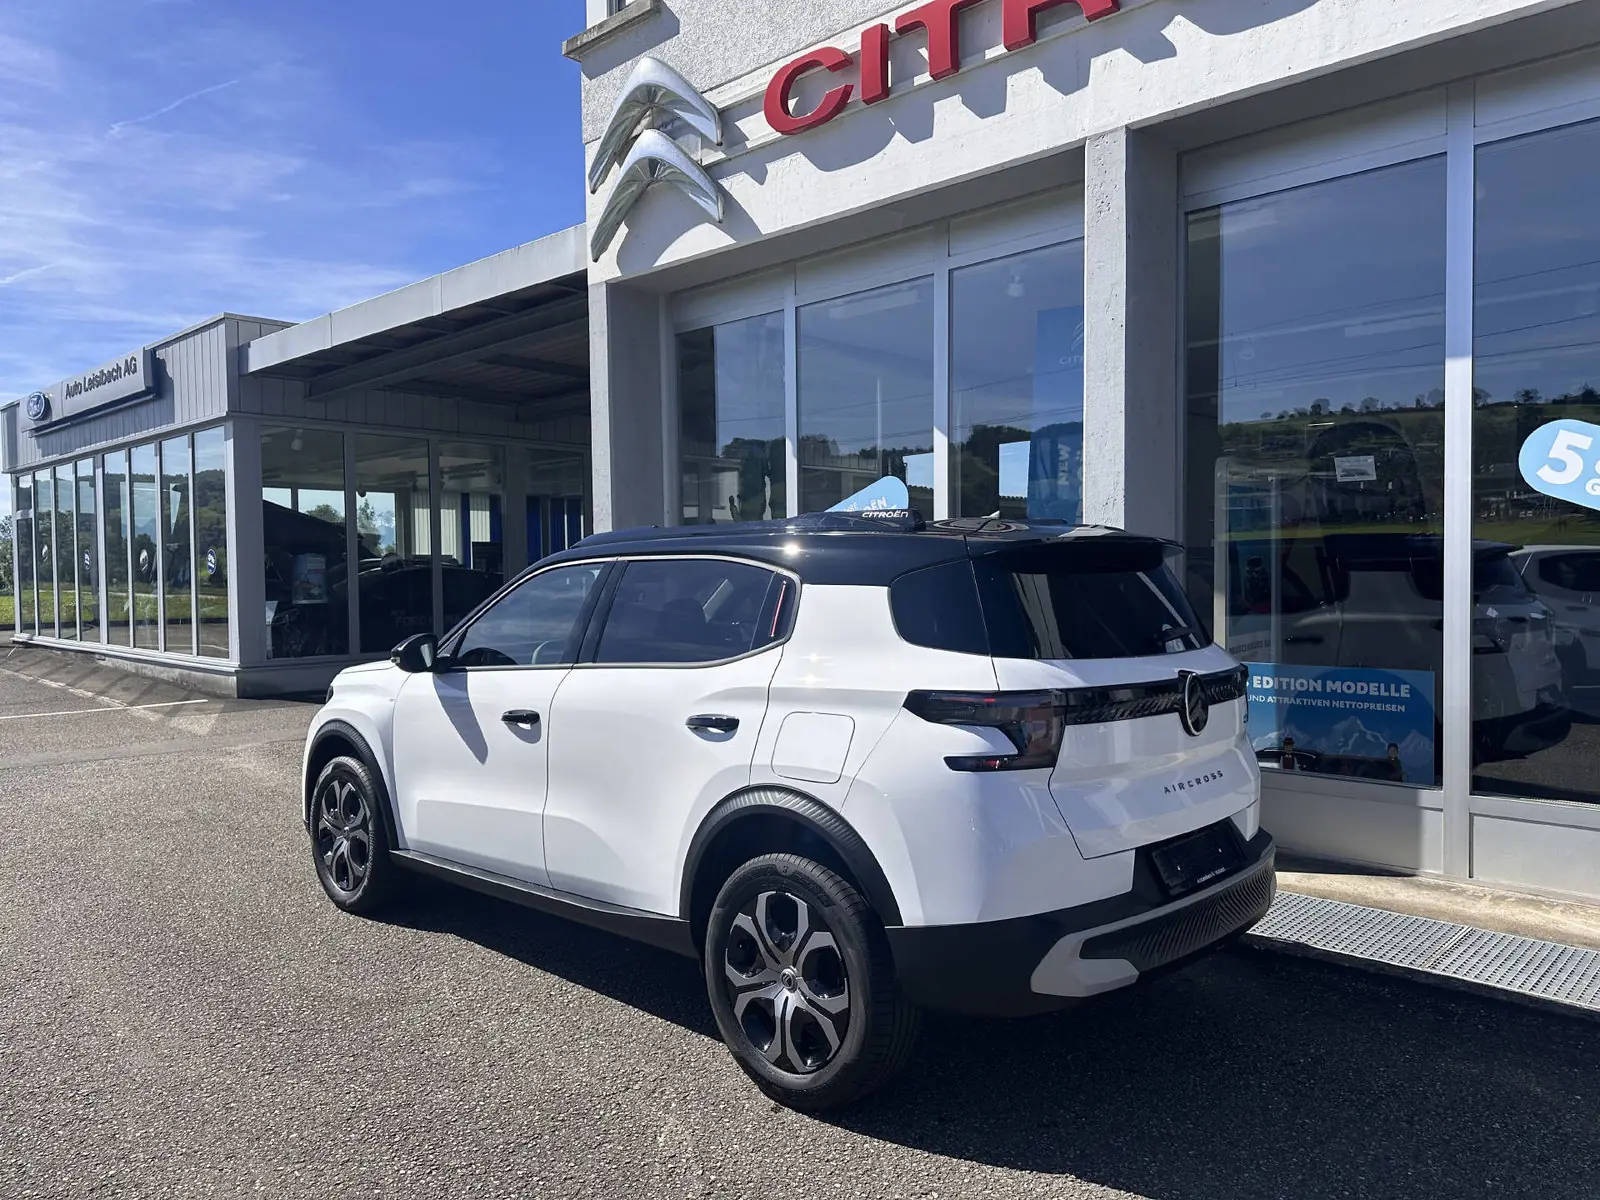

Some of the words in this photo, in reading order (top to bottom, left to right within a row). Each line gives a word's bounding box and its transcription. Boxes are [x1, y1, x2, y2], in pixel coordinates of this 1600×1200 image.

[65, 380, 82, 400] Auto
[123, 356, 138, 377] AG
[1536, 429, 1594, 485] 5
[1252, 675, 1322, 693] EDITION
[1326, 680, 1411, 698] MODELLE
[1267, 695, 1330, 708] ATTRAKTIVEN
[1332, 700, 1406, 713] NETTOPREISEN
[1163, 770, 1224, 794] AIRCROSS
